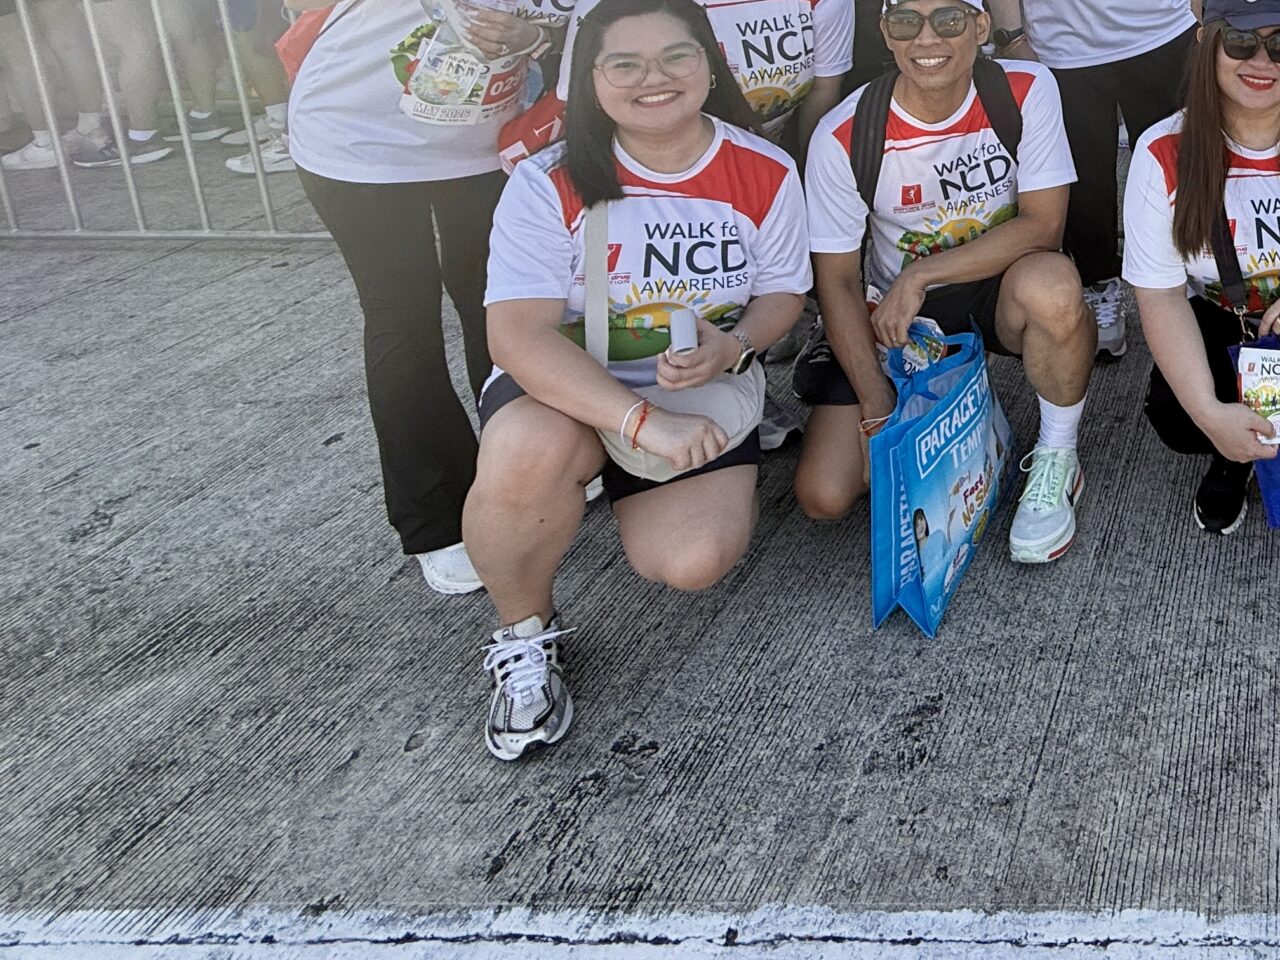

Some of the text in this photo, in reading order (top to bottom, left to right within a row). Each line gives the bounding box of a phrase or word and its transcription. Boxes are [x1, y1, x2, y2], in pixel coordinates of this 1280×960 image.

[736, 14, 795, 37] WALK
[981, 142, 1002, 157] for
[939, 155, 1011, 200] NCD
[644, 222, 715, 240] WALK
[643, 240, 747, 278] NCD
[640, 272, 749, 294] AWARENESS
